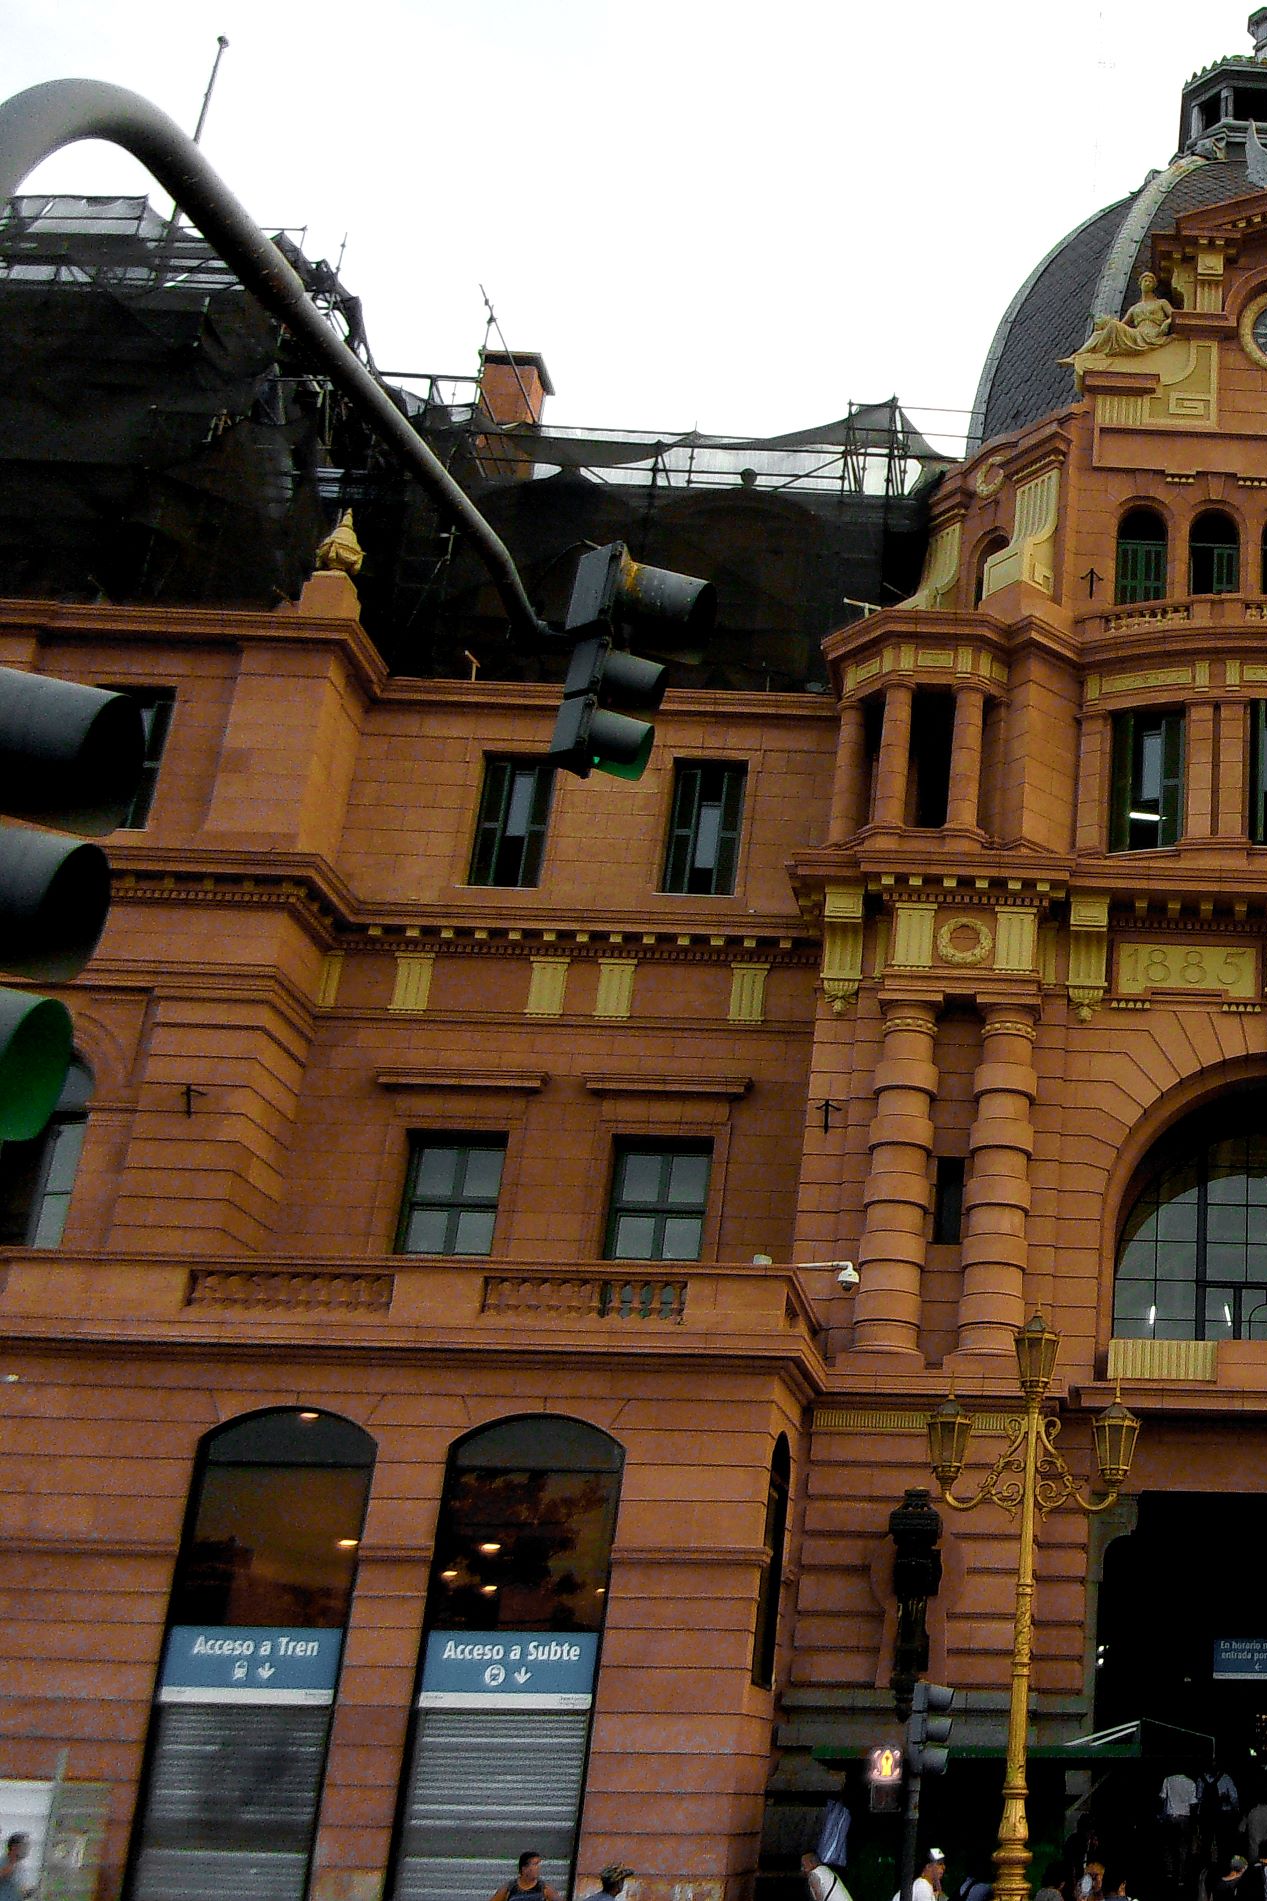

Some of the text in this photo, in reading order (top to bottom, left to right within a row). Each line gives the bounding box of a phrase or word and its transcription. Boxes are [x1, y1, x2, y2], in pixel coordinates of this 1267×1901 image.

[1123, 947, 1247, 985] 1885
[193, 1634, 320, 1656] Acceso a Tren
[442, 1640, 581, 1661] Acceso a Subte
[1220, 1640, 1230, 1649] En
[1232, 1639, 1261, 1650] horario
[1221, 1650, 1252, 1659] entrada
[1254, 1652, 1267, 1661] por
